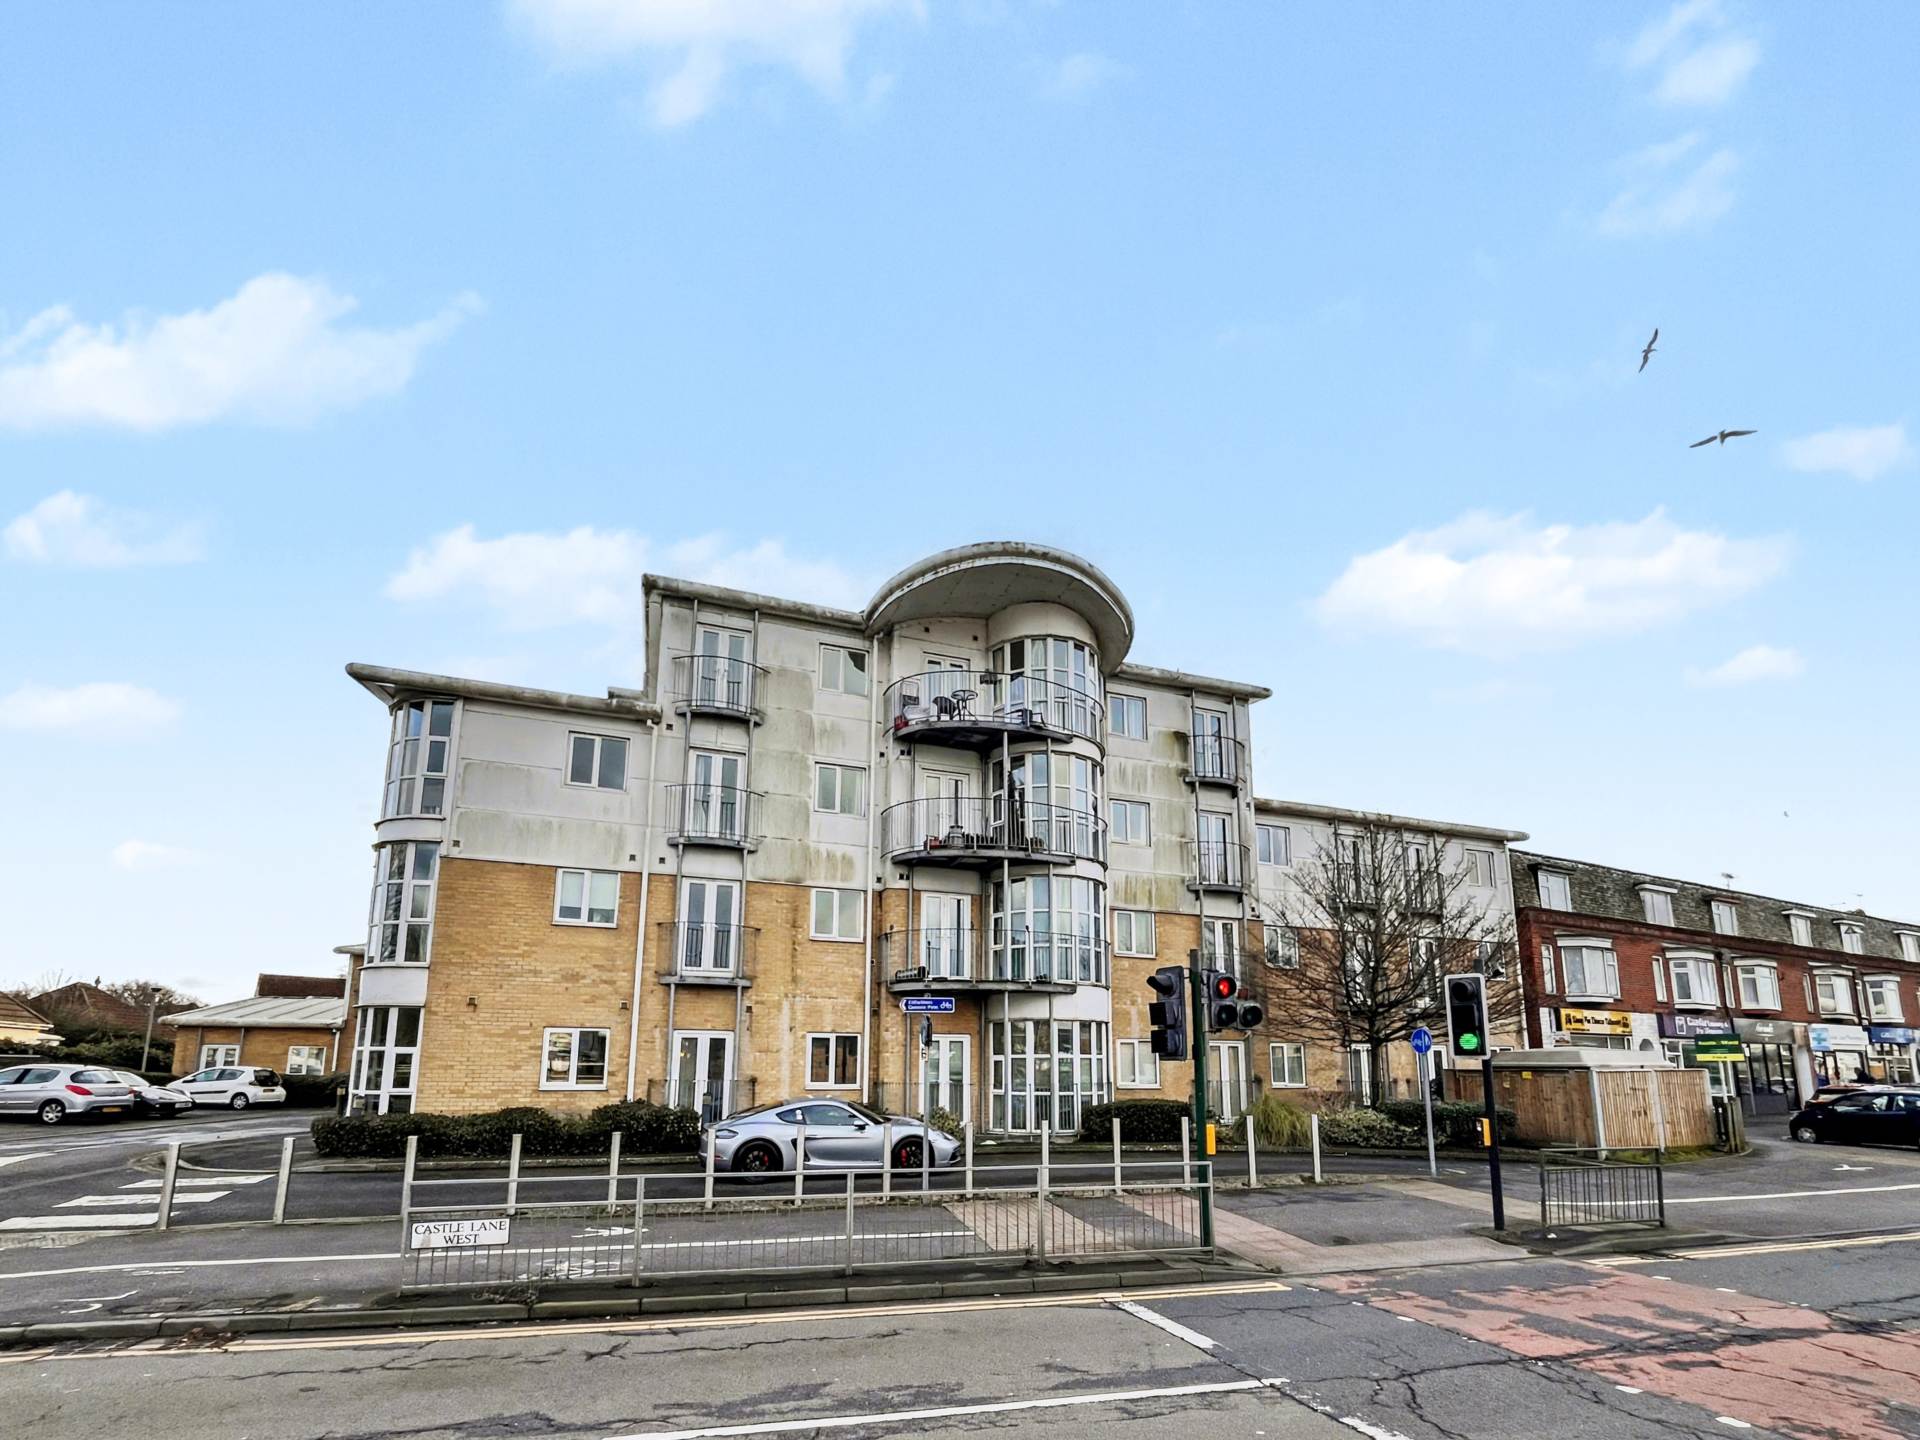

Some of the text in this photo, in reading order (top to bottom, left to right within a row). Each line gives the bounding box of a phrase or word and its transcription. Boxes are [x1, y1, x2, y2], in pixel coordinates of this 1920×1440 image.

[414, 1221, 506, 1234] CASTLE LANE
[444, 1234, 479, 1244] WEST
